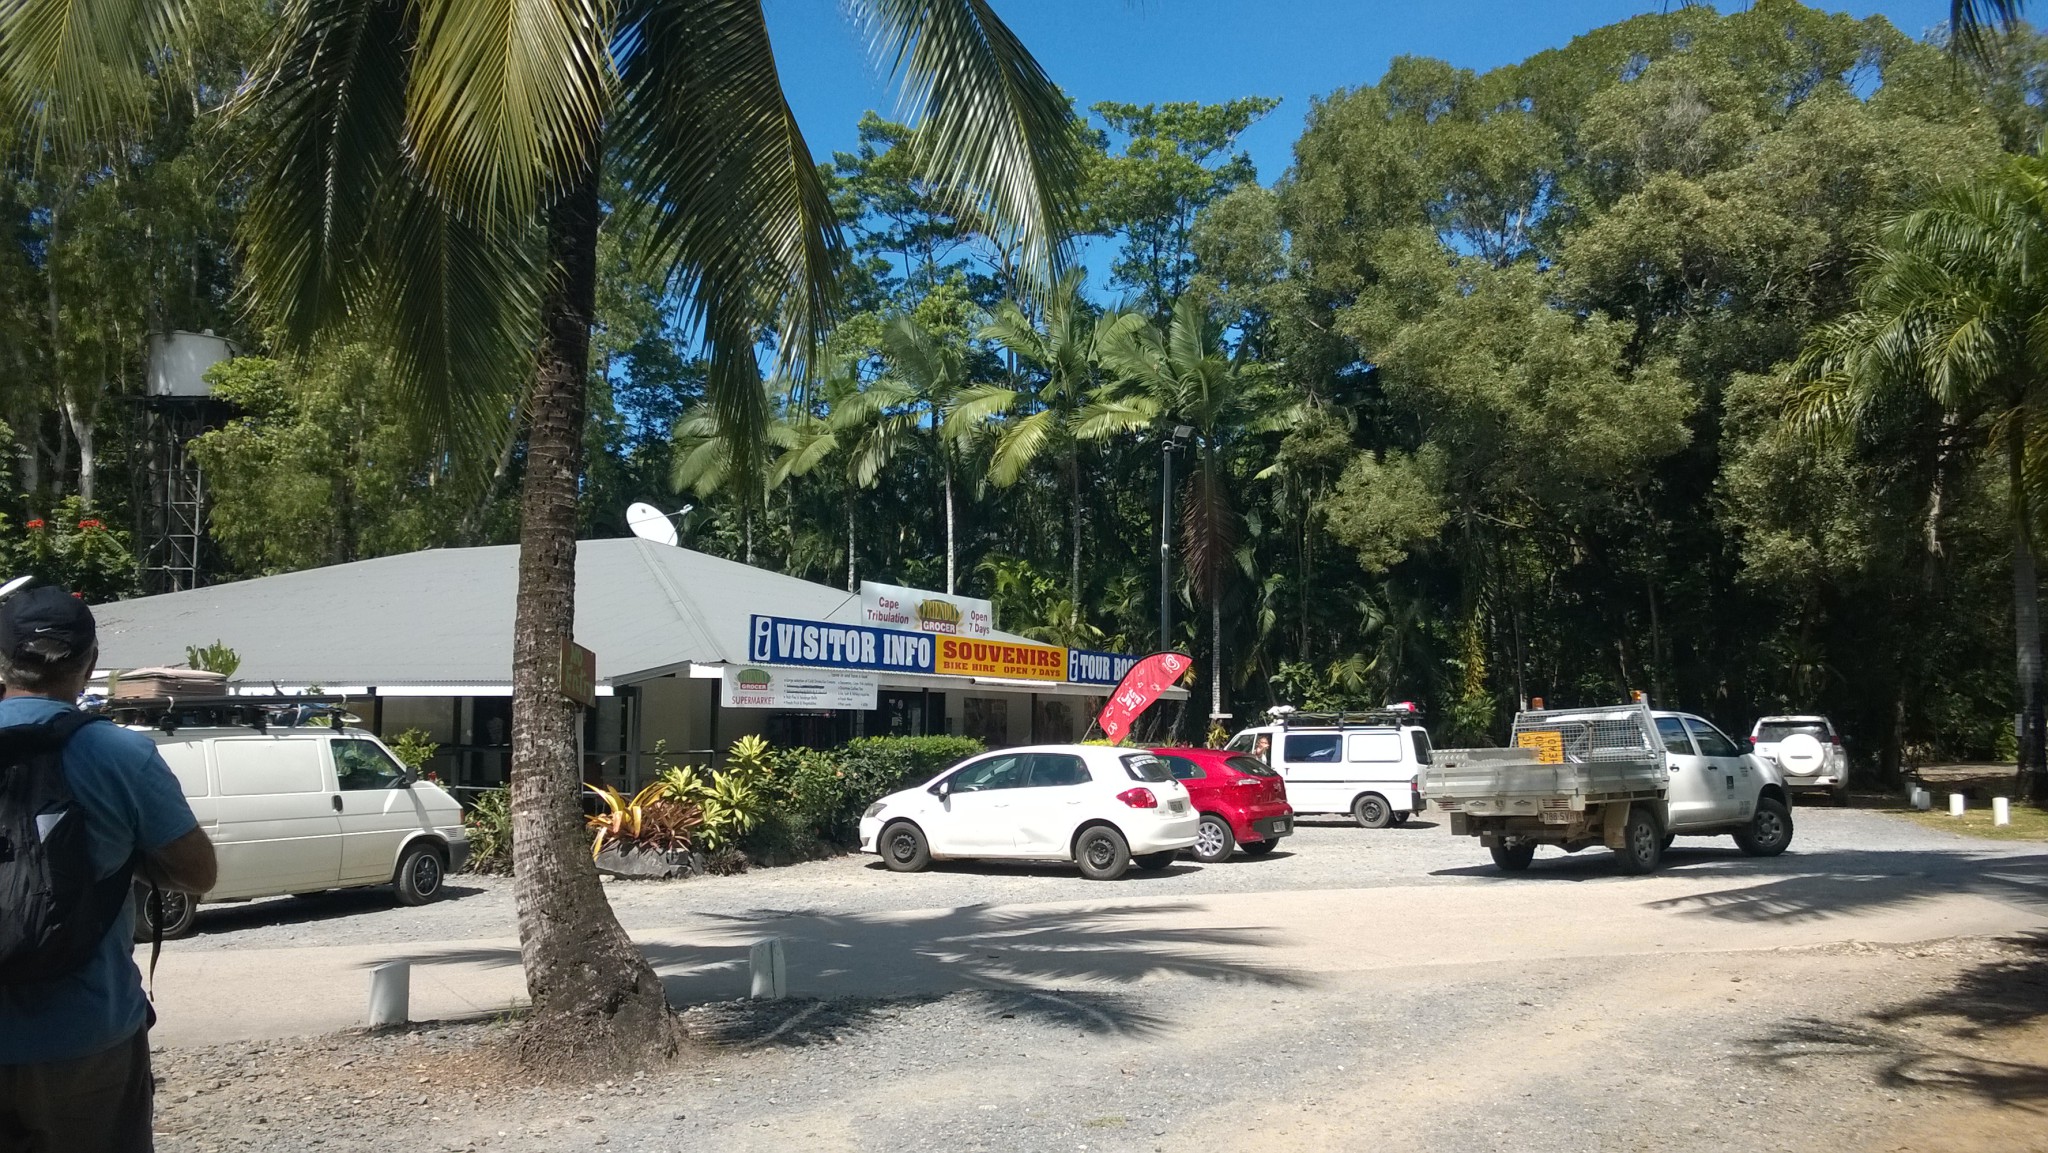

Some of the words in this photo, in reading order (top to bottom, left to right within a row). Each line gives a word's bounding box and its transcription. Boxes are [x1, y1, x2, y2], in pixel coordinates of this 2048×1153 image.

[879, 596, 899, 611] Cape
[867, 609, 909, 625] Tribulation
[971, 610, 988, 622] Open
[923, 620, 956, 634] GROCER
[969, 622, 974, 632] 7
[975, 623, 990, 637] Days
[777, 623, 876, 663] VISITOR
[883, 633, 931, 668] INFO
[943, 640, 1061, 668] SOUVENIRS
[943, 661, 968, 670] BIKE
[972, 663, 996, 673] HIRE
[1003, 666, 1028, 676] OPEN
[1031, 668, 1037, 676] 7
[1039, 668, 1061, 678] DAYS
[1080, 654, 1111, 680] TOUR
[731, 695, 776, 705] SUPERMARKET
